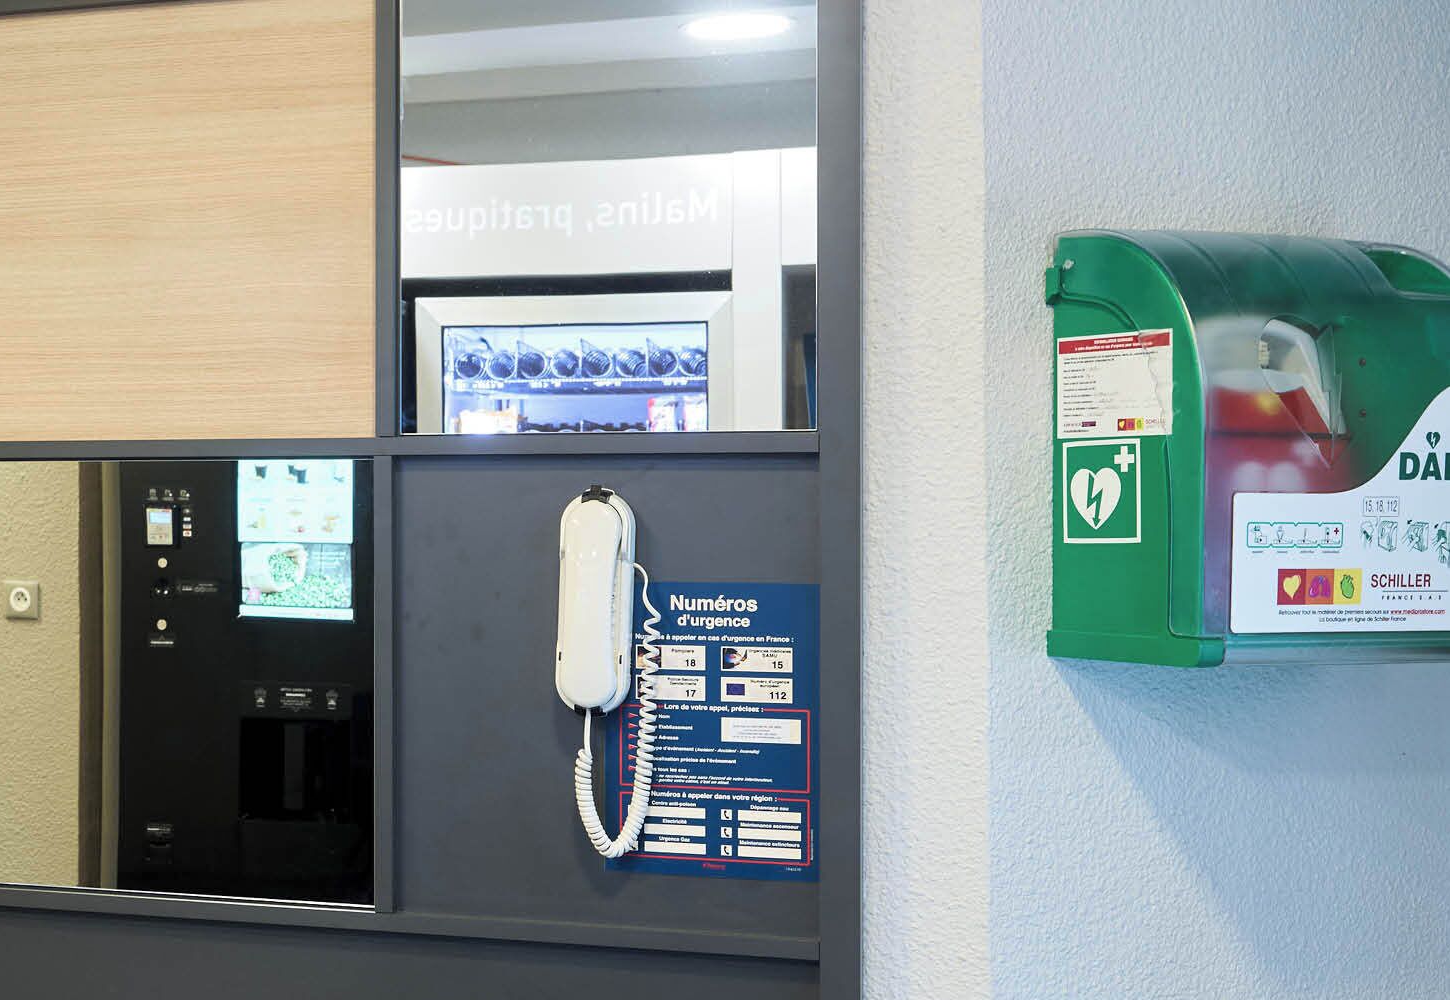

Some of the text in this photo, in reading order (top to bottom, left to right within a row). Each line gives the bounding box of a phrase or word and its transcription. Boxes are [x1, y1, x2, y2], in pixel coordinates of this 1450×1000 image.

[1387, 500, 1398, 512] 112
[1371, 573, 1431, 588] SCHILLER
[670, 594, 758, 612] Numéros
[677, 614, 751, 630] d'urgence
[672, 634, 696, 642] appeler
[721, 635, 755, 643] d'urgence
[766, 635, 790, 643] France
[685, 659, 696, 667] 18
[772, 661, 784, 669] 15
[685, 689, 696, 697] 17
[770, 692, 787, 700] 112
[731, 705, 760, 713] précisez
[651, 790, 680, 798] Numéros
[751, 795, 773, 803] région
